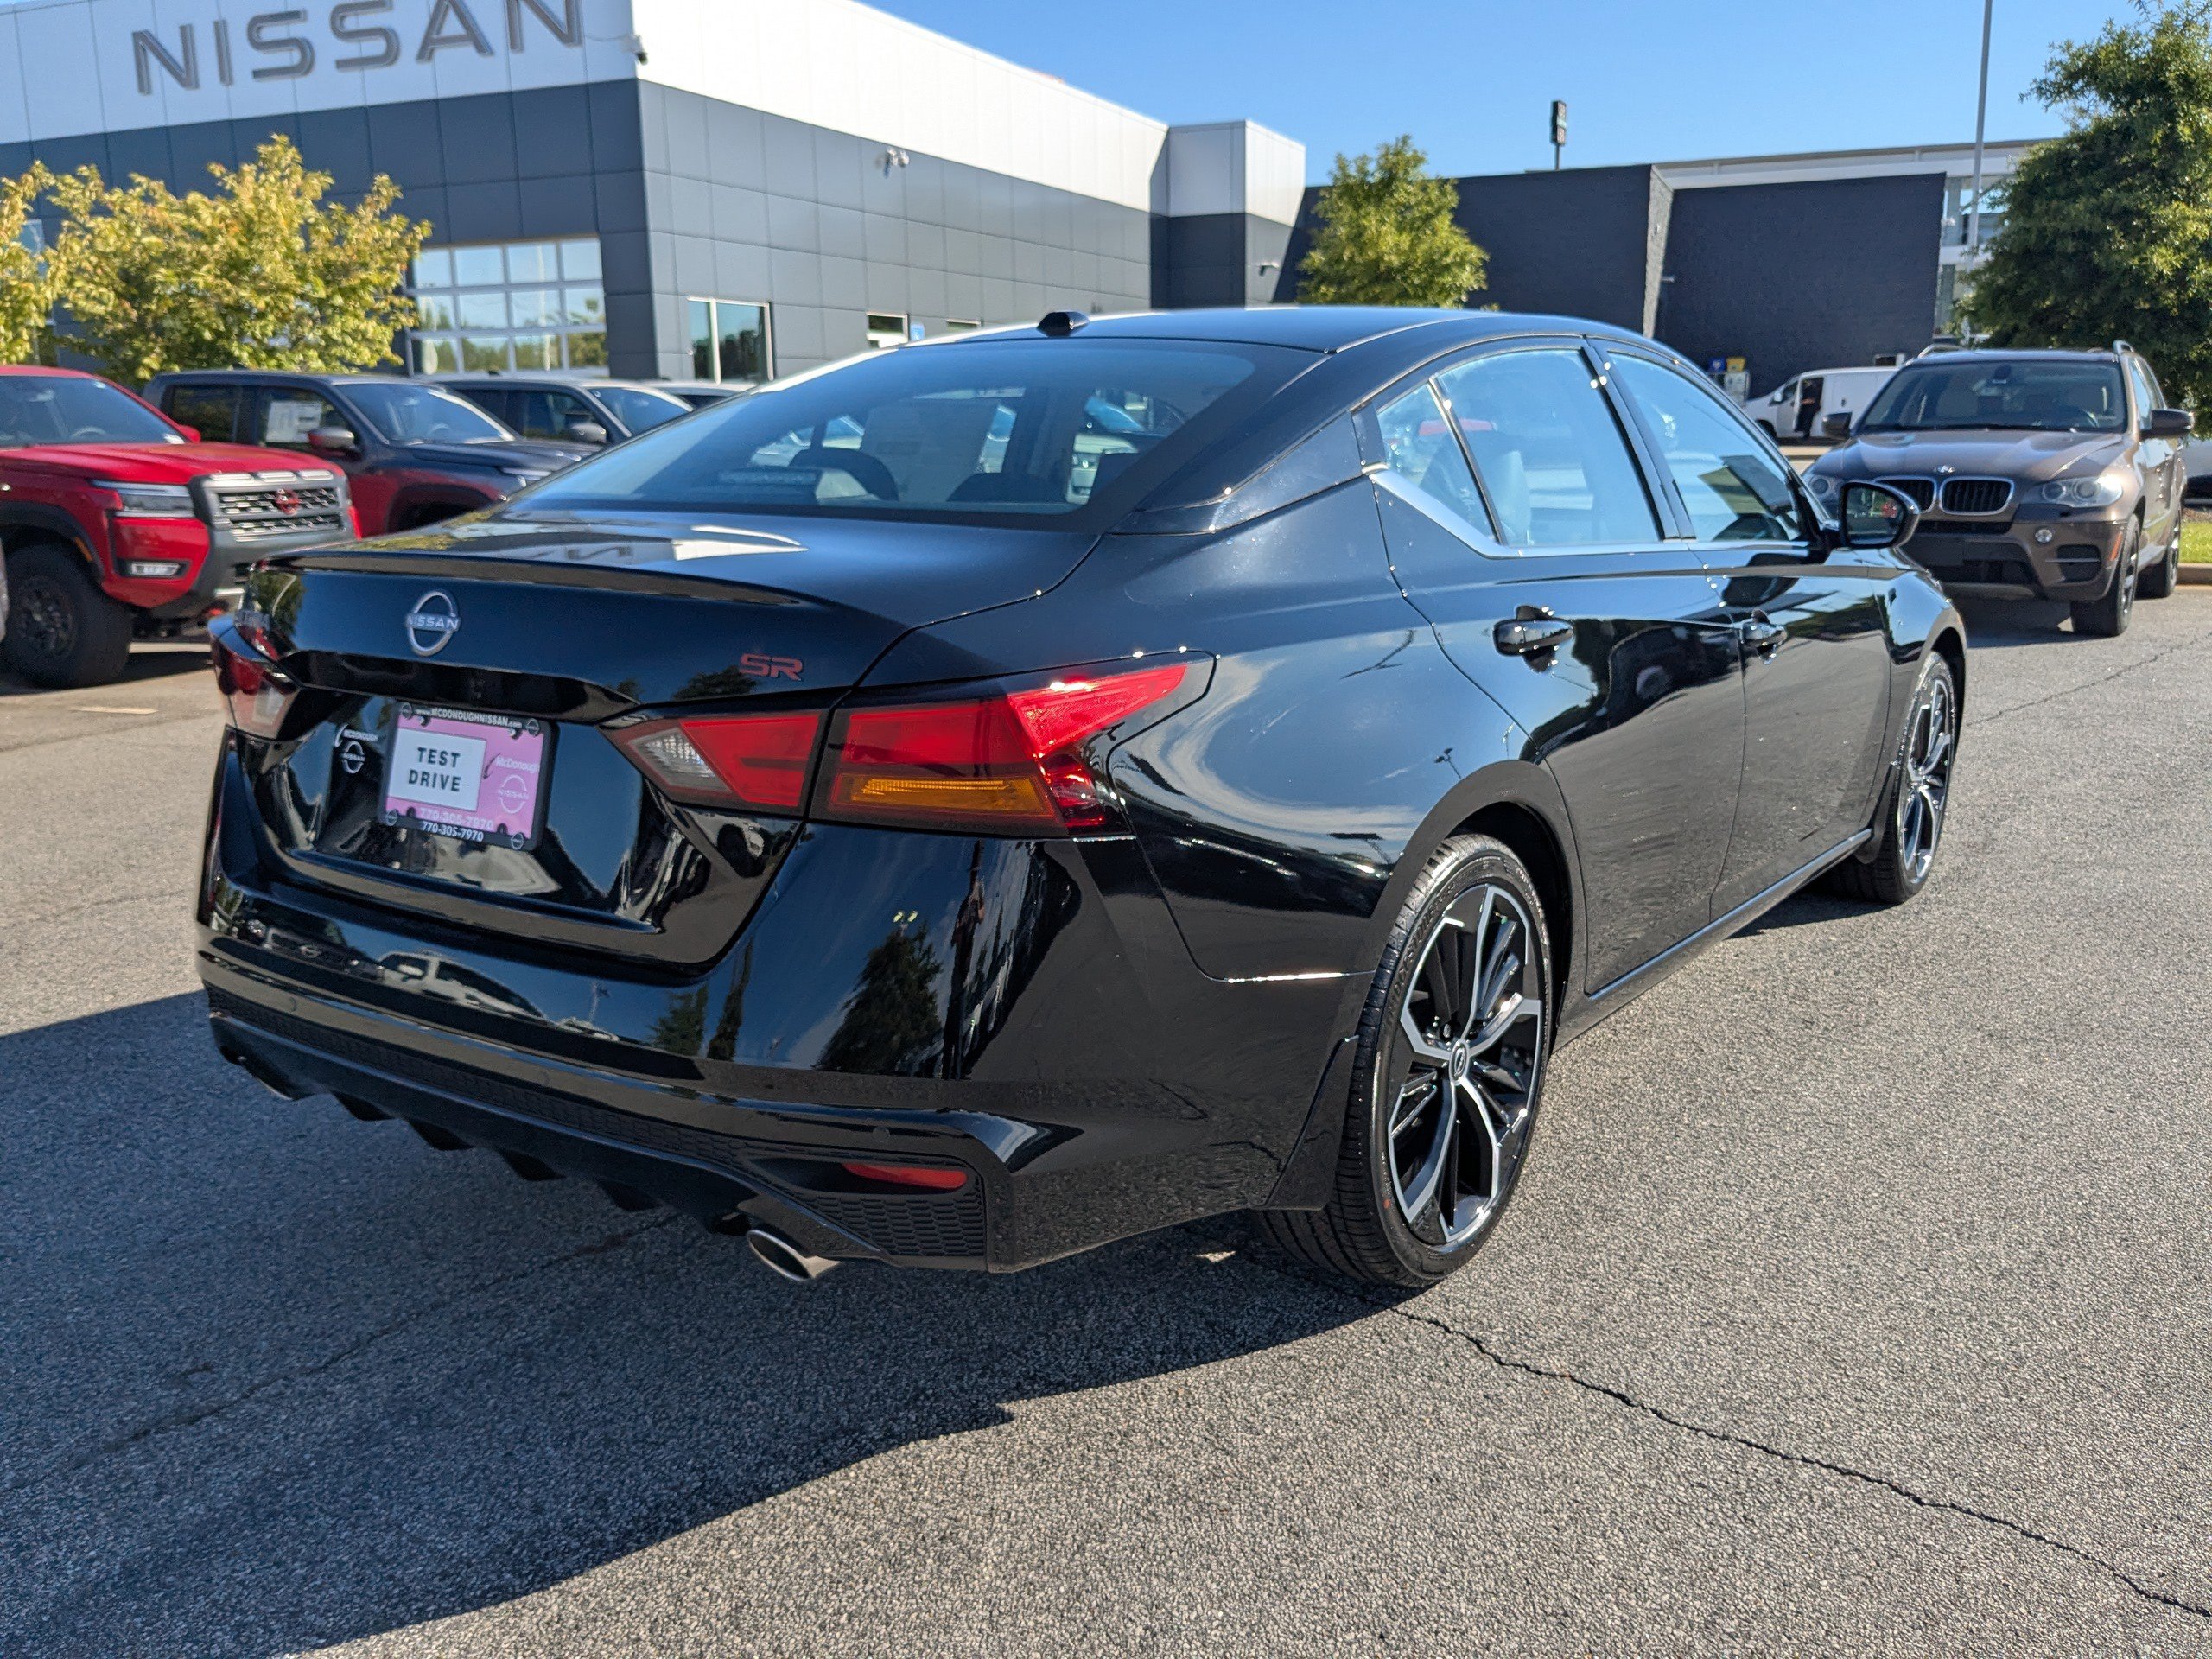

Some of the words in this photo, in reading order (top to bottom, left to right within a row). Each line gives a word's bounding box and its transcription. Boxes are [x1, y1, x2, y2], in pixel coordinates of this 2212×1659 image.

[131, 0, 582, 95] NISSAN
[406, 614, 459, 629] NISSAN
[740, 653, 803, 681] SR
[417, 747, 461, 768] TEST
[408, 769, 461, 792] DRIVE
[422, 821, 484, 842] 770-305-7970
